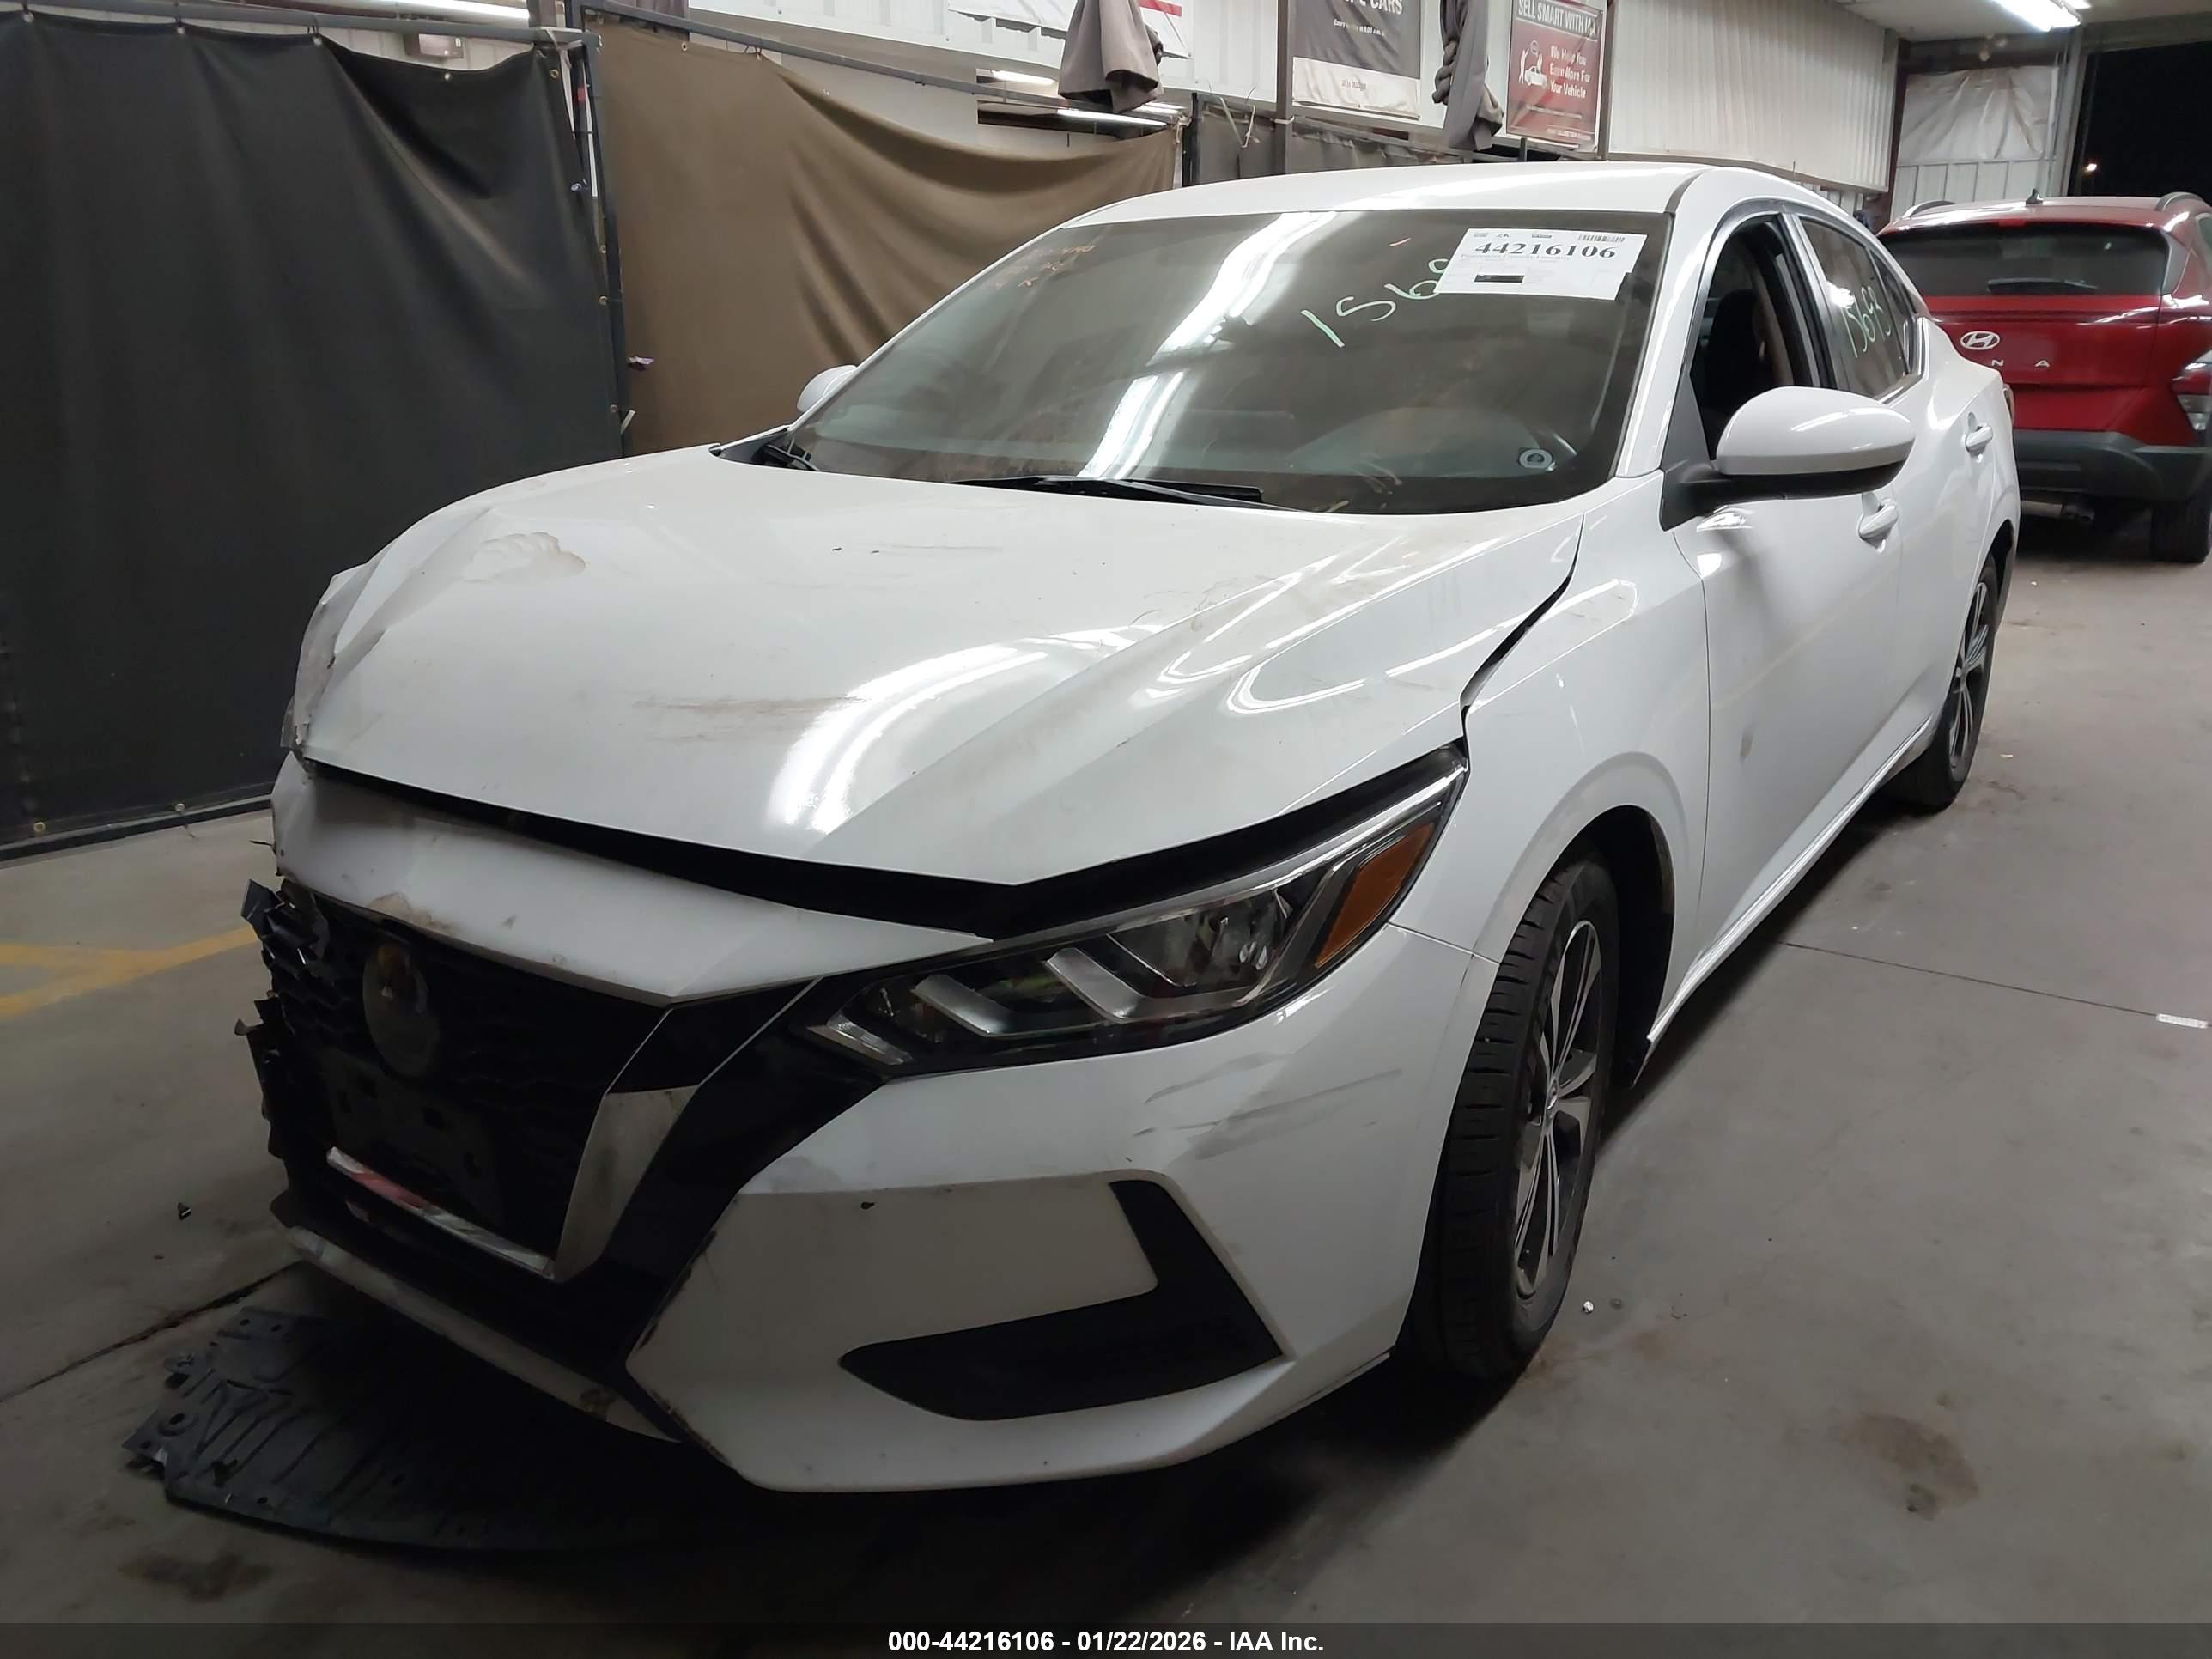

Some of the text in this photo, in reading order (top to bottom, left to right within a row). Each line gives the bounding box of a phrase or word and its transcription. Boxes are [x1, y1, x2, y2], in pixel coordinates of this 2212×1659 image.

[1370, 0, 1402, 15] CARS
[1518, 0, 1536, 19] SELL
[1537, 2, 1565, 27] SMART
[1565, 10, 1583, 34] WITH
[1550, 45, 1560, 60] We
[1576, 52, 1587, 66] You
[1549, 62, 1565, 76] Earn
[1565, 66, 1580, 81] More
[1550, 79, 1587, 99] Your Vehicle
[1474, 241, 1619, 258] 44216106
